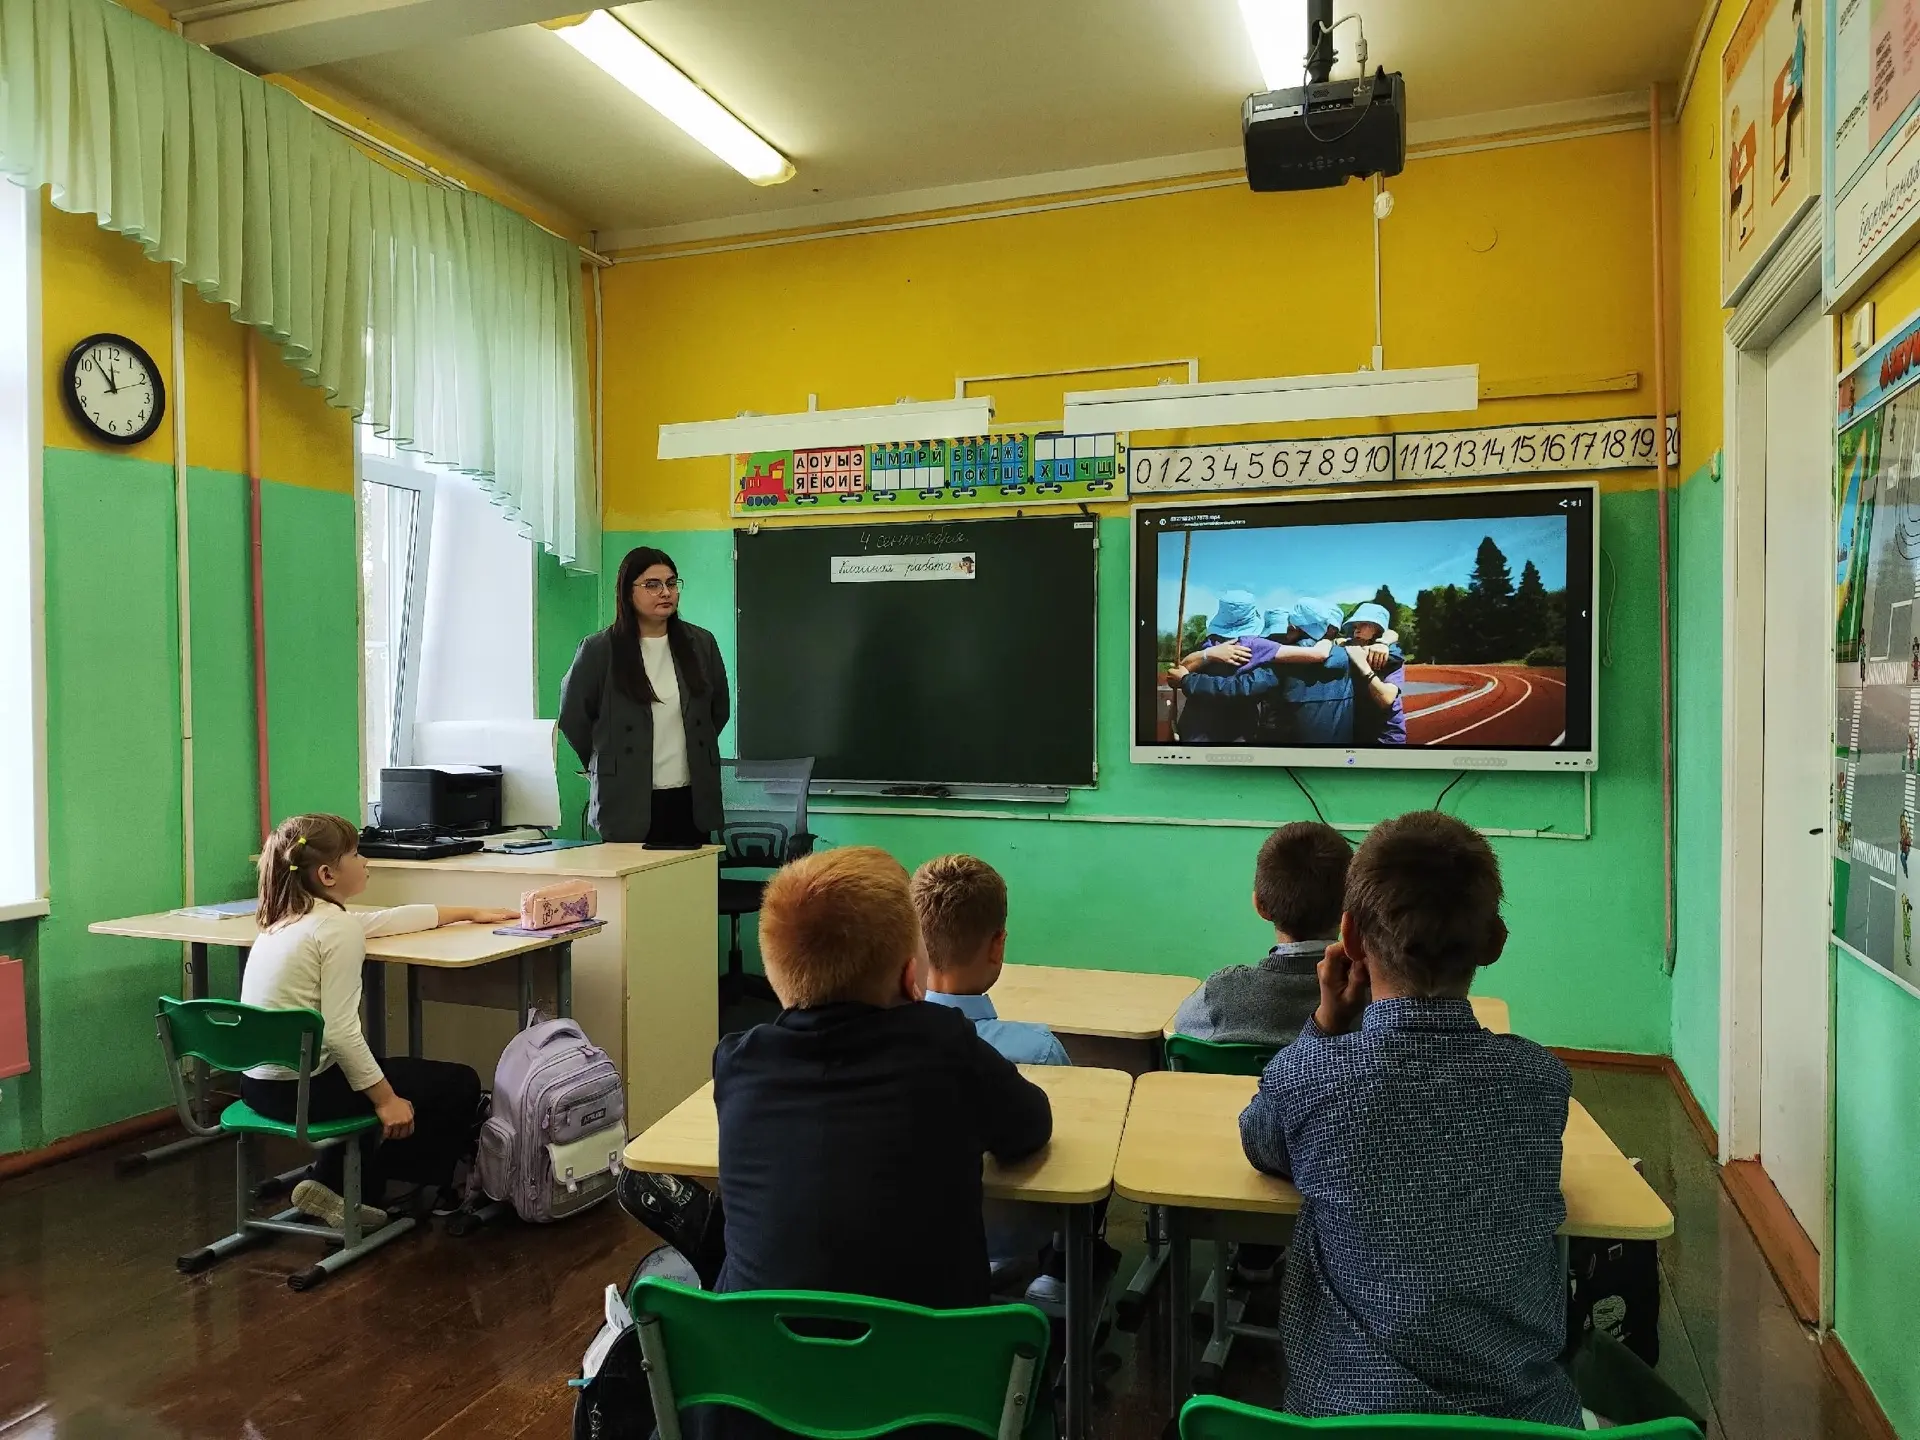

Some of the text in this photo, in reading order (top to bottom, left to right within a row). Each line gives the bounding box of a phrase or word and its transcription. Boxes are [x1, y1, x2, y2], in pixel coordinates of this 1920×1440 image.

[108, 347, 120, 361] 12
[81, 359, 92, 372] 10
[129, 357, 133, 369] 1
[75, 376, 82, 389] 9
[139, 373, 146, 385] 2
[80, 395, 87, 408] 8
[144, 392, 151, 404] 3
[93, 412, 100, 424] 7
[137, 409, 145, 421] 4
[108, 420, 116, 432] 6
[126, 420, 133, 431] 5
[1400, 443, 1420, 471] 11
[1424, 441, 1448, 469] 12
[1453, 440, 1477, 468] 13
[1482, 437, 1505, 465] 14
[1511, 435, 1536, 463] 15
[1540, 433, 1565, 462] 16
[1571, 432, 1597, 461] 17
[1601, 429, 1626, 459] 18
[1631, 428, 1655, 457] 19
[1136, 445, 1390, 484] 0 1 2 3 4 5 6 7 8 9 10
[860, 531, 871, 550] 4
[904, 556, 952, 577] работа
